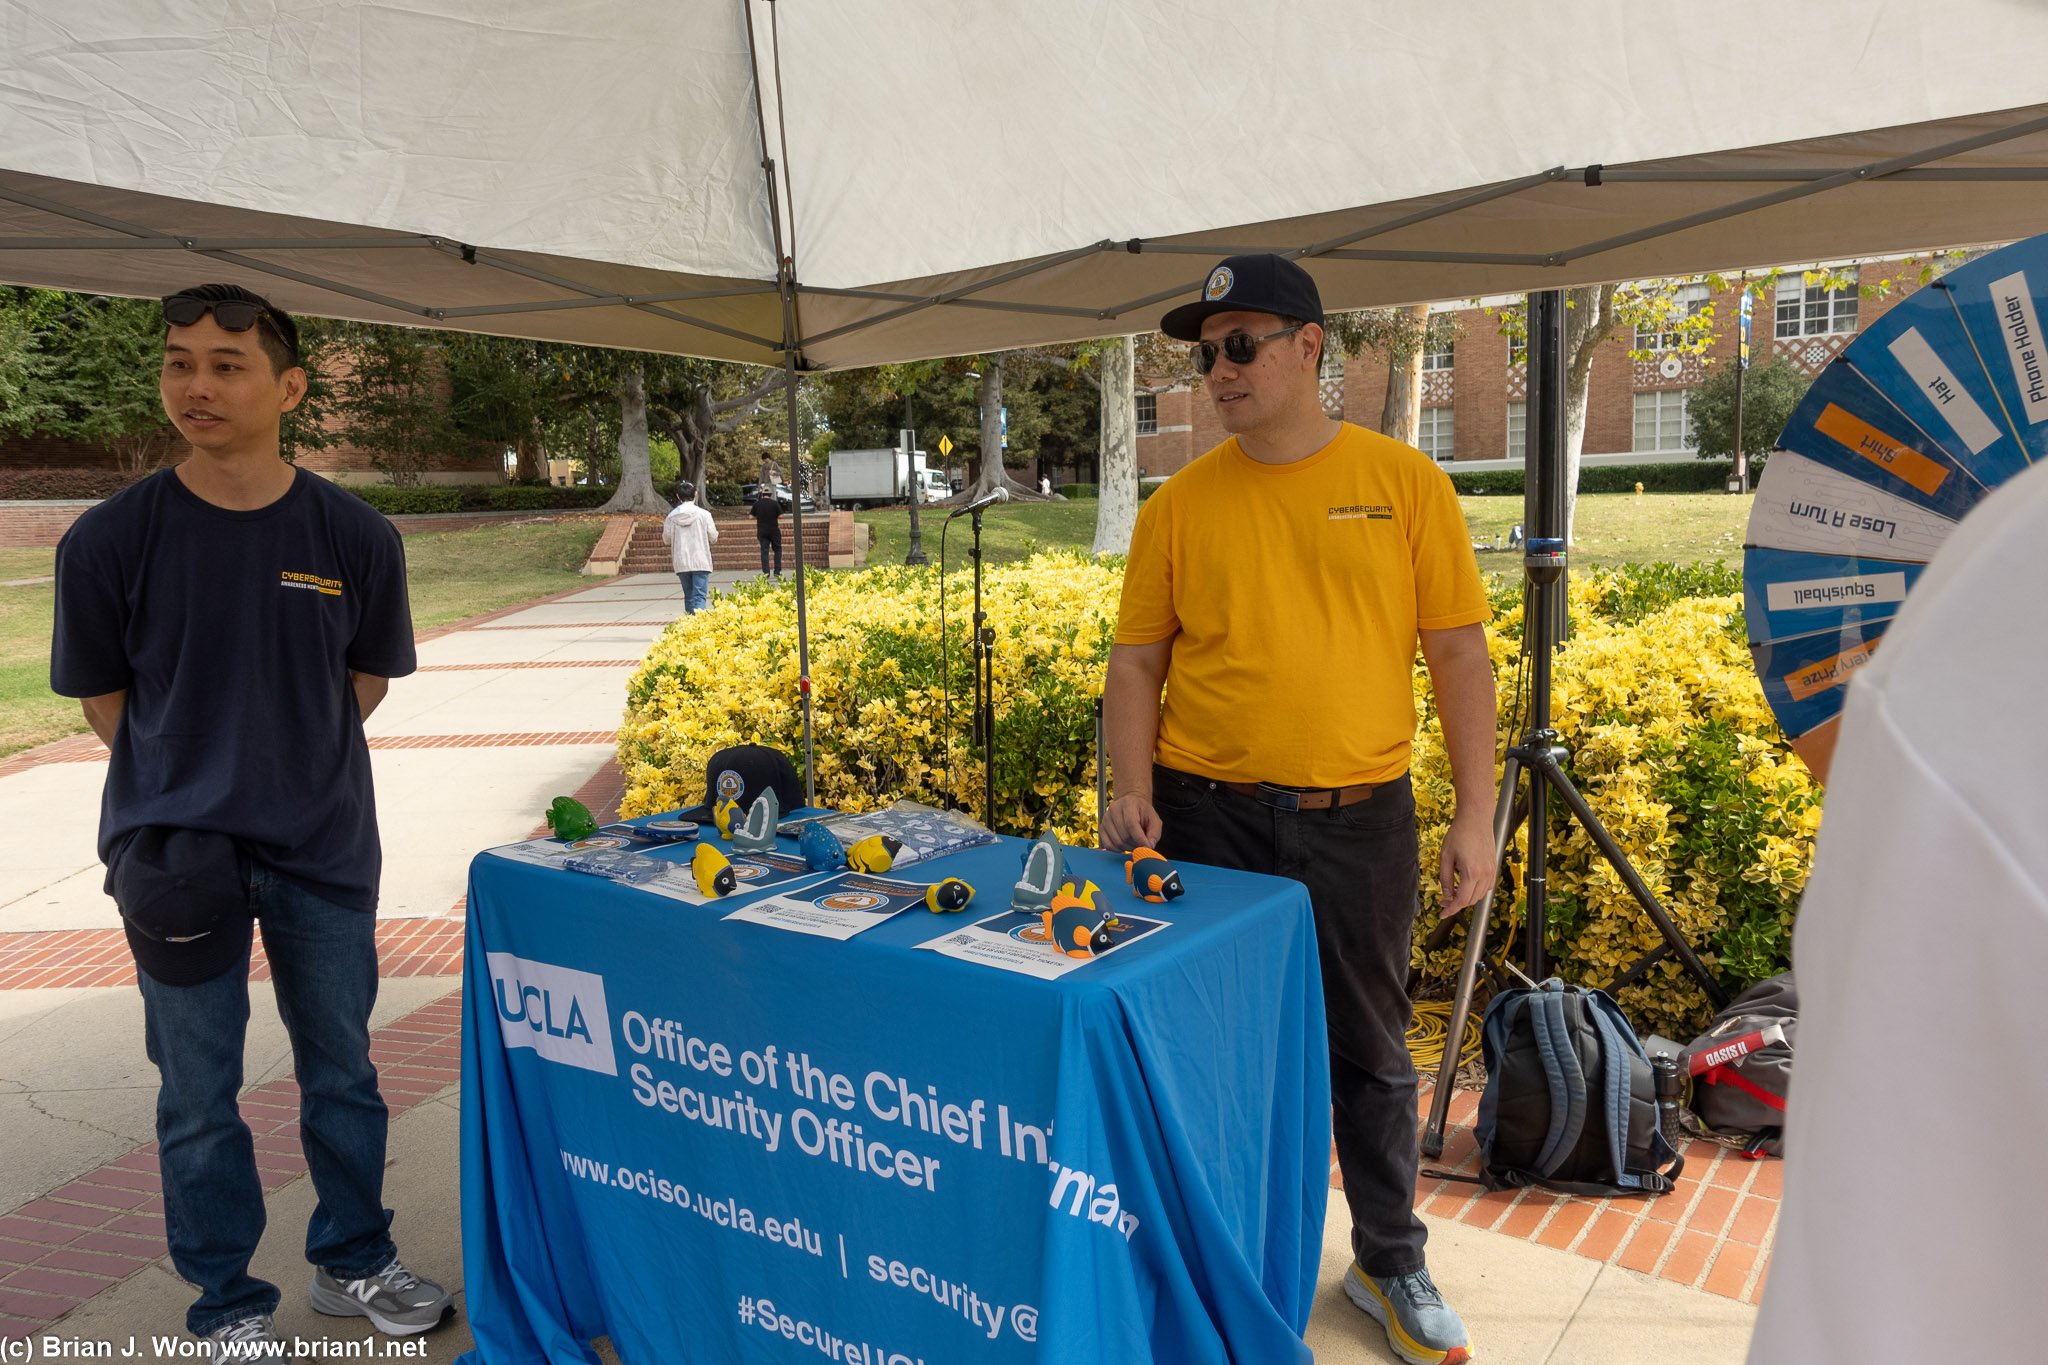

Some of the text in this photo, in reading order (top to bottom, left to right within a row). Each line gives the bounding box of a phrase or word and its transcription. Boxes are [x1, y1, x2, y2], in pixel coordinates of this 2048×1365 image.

[2004, 295, 2048, 404] Phone Holder
[1928, 376, 1956, 405] Hat
[1860, 435, 1897, 464] Shirt
[1328, 505, 1393, 515] CYBERSECURITY
[1789, 501, 1897, 539] Lose A Turn
[281, 571, 343, 589] CYBERSECURITY
[1793, 582, 1876, 604] Squishball
[1801, 664, 1841, 688] Prize
[495, 978, 594, 1045] UCLA
[1705, 1041, 1749, 1067] OASIS II
[621, 1010, 733, 1077] Office
[739, 1045, 779, 1090] of
[786, 1052, 856, 1111] the
[864, 1071, 987, 1150] Chief
[630, 1063, 941, 1192] Security Officer
